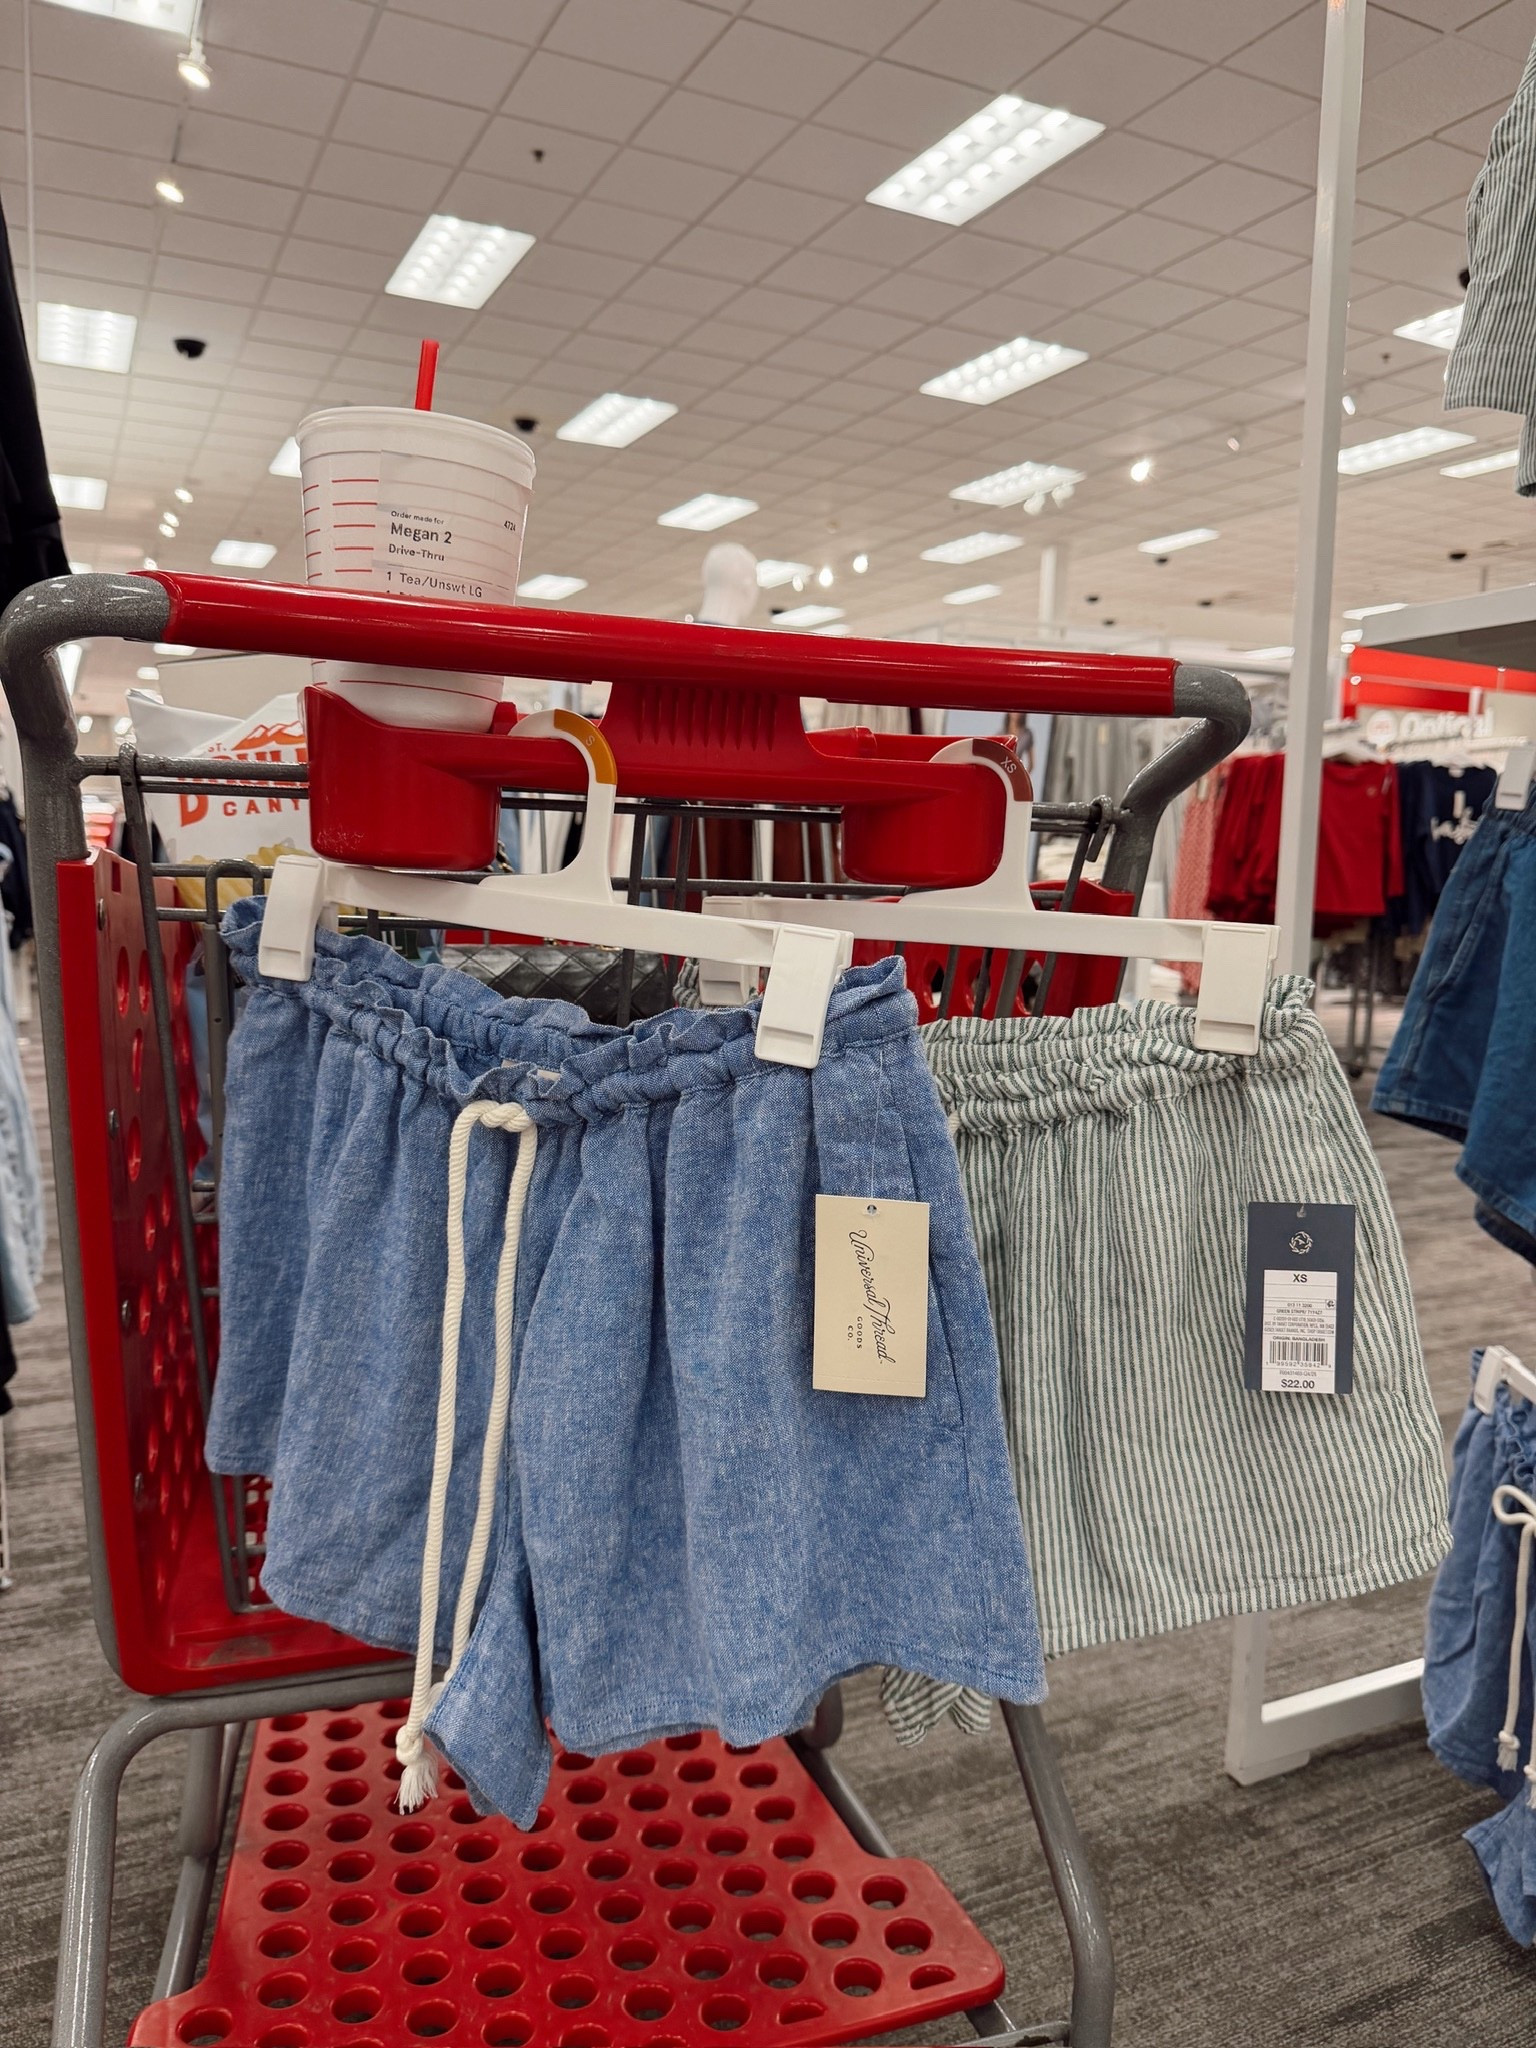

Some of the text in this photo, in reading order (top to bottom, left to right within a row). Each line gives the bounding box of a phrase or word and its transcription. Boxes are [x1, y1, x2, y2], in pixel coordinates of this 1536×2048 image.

[391, 510, 444, 525] Order made for
[390, 522, 452, 544] Megan 2
[503, 520, 516, 532] 4724
[389, 543, 445, 561] Drive-Thru
[387, 571, 392, 581] 1
[400, 572, 465, 594] Tea/Unswt
[469, 585, 482, 598] LG
[585, 735, 596, 747] S
[1000, 755, 1017, 774] XS
[1293, 1273, 1307, 1283] XS
[849, 1229, 896, 1364] Universal Thread
[1281, 1379, 1315, 1389] $22.00
